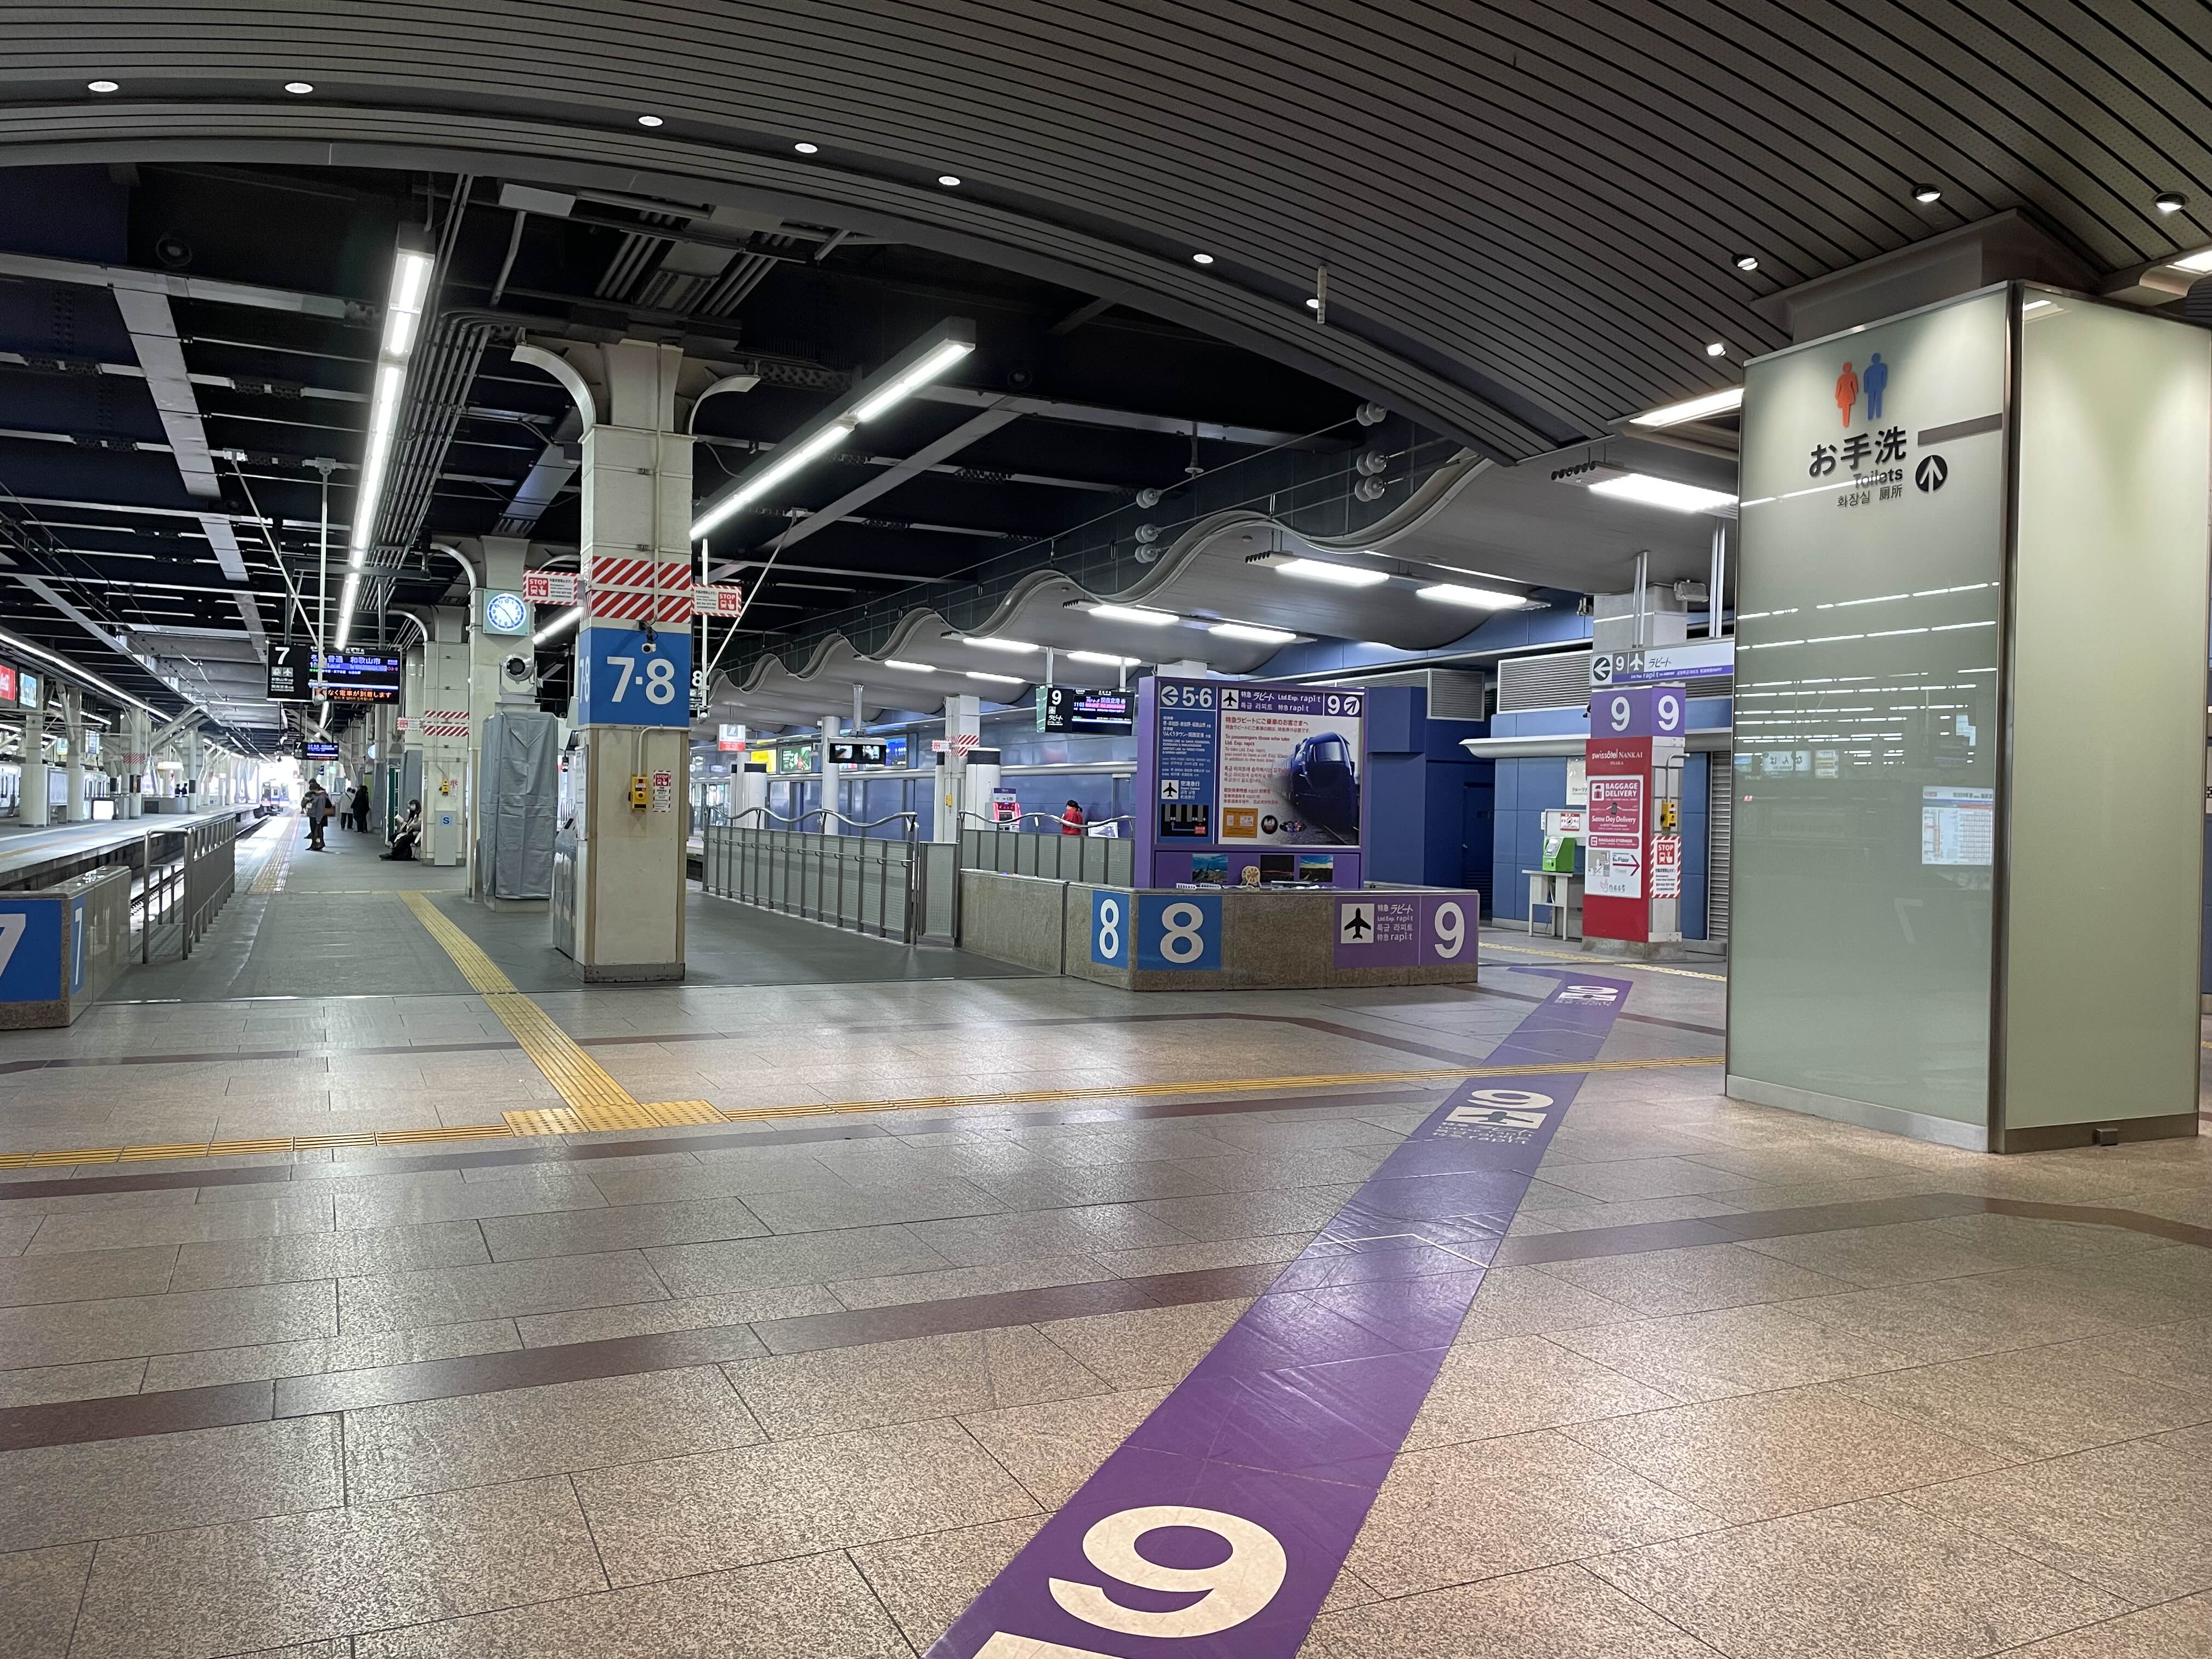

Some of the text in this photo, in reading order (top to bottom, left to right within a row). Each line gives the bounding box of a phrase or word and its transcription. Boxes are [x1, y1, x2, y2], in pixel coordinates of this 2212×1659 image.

[1809, 426, 1906, 477] お手洗
[1853, 469, 1903, 489] Toilets
[1838, 491, 1870, 507] 화장실
[275, 647, 290, 664] 7
[349, 656, 381, 664] 和歌山市
[1649, 657, 1672, 668] ラピート
[1615, 656, 1625, 672] 9
[692, 670, 703, 686] 8
[315, 689, 392, 698] なく電車が到着します
[1052, 690, 1062, 705] 9
[1253, 692, 1274, 701] ラピート
[1328, 695, 1340, 714] 9
[1611, 697, 1630, 731] 9
[1658, 695, 1679, 731] 9
[1592, 749, 1618, 759] swissôtel
[1616, 816, 1636, 825] Delivery
[1391, 904, 1413, 915] ラピート
[1099, 899, 1119, 959] 8
[1160, 902, 1204, 964] 8
[1377, 924, 1390, 932] 특급
[1434, 902, 1465, 958] 9
[75, 907, 82, 985] 7
[1567, 985, 1618, 994] 9
[1467, 1090, 1554, 1109] 9
[1048, 1505, 1287, 1638] 9
